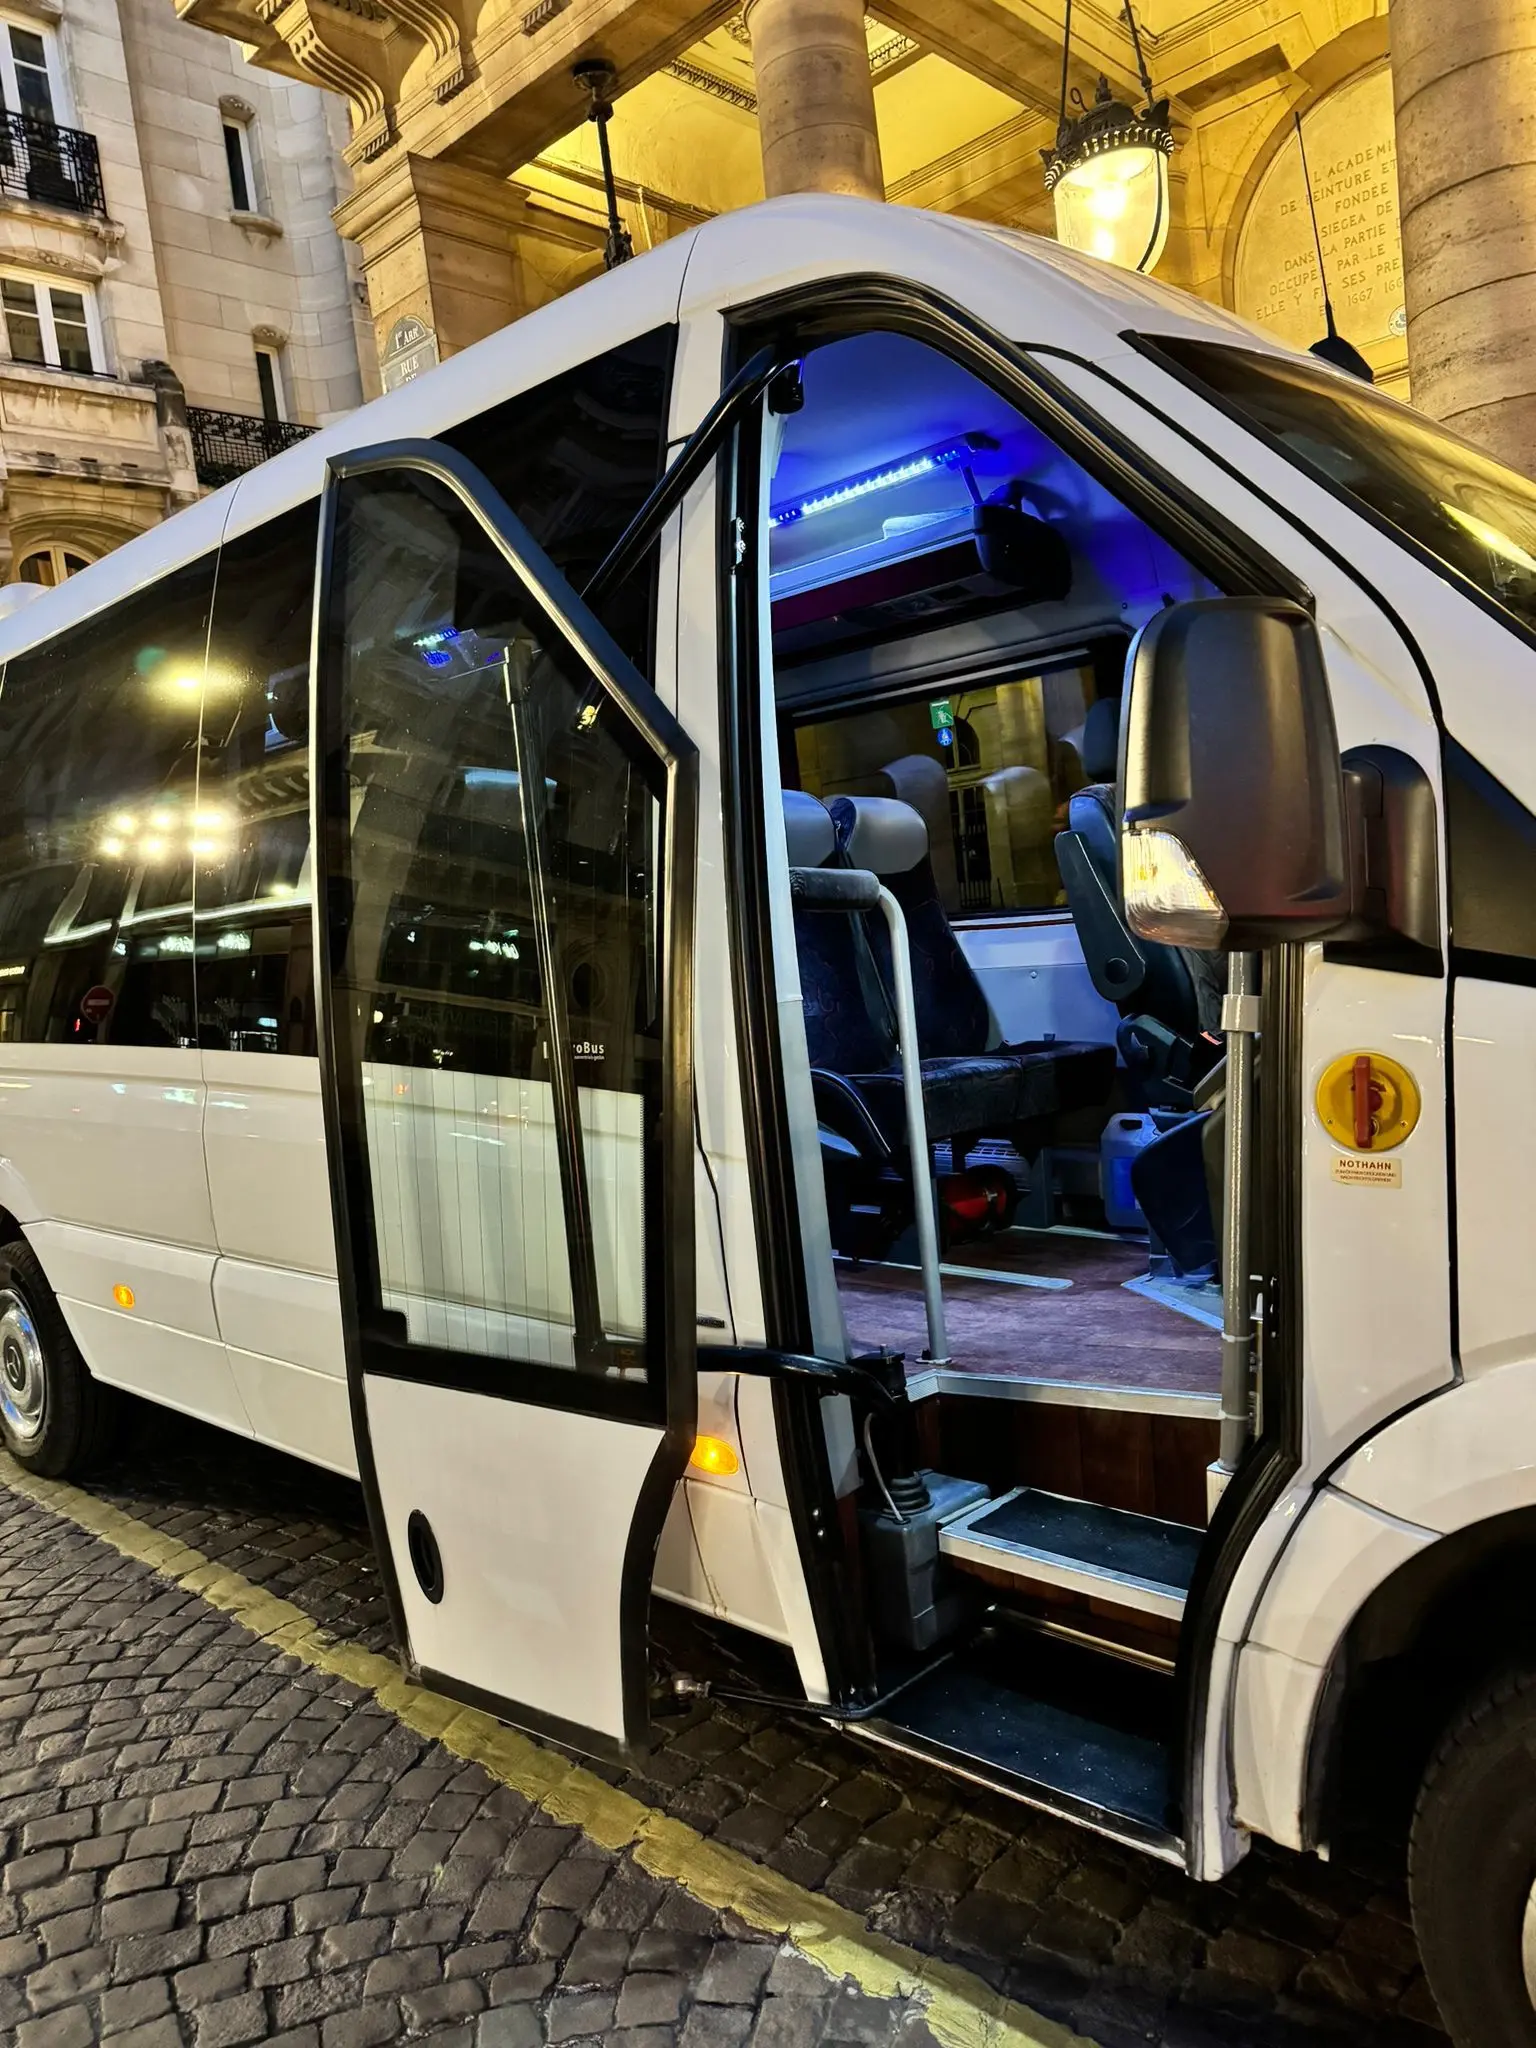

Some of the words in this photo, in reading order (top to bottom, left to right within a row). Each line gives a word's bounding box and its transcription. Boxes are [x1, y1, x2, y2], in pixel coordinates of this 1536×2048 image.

[1280, 199, 1297, 216] DE
[1381, 158, 1397, 175] ET
[1376, 200, 1393, 217] DE
[1284, 250, 1316, 273] DANS
[1322, 243, 1338, 258] LA
[1344, 223, 1387, 249] PARTIE
[1337, 253, 1360, 272] PAR
[1369, 243, 1386, 260] LE
[1256, 300, 1287, 320] ELLE
[1293, 293, 1302, 306] Y
[1342, 270, 1366, 290] SES
[1376, 257, 1401, 277] PRE
[1347, 286, 1373, 307] 1667
[1384, 276, 1403, 294] 166
[400, 354, 419, 377] RUE
[573, 1041, 605, 1054] oBus
[1339, 1159, 1392, 1170] NOTHAHN
